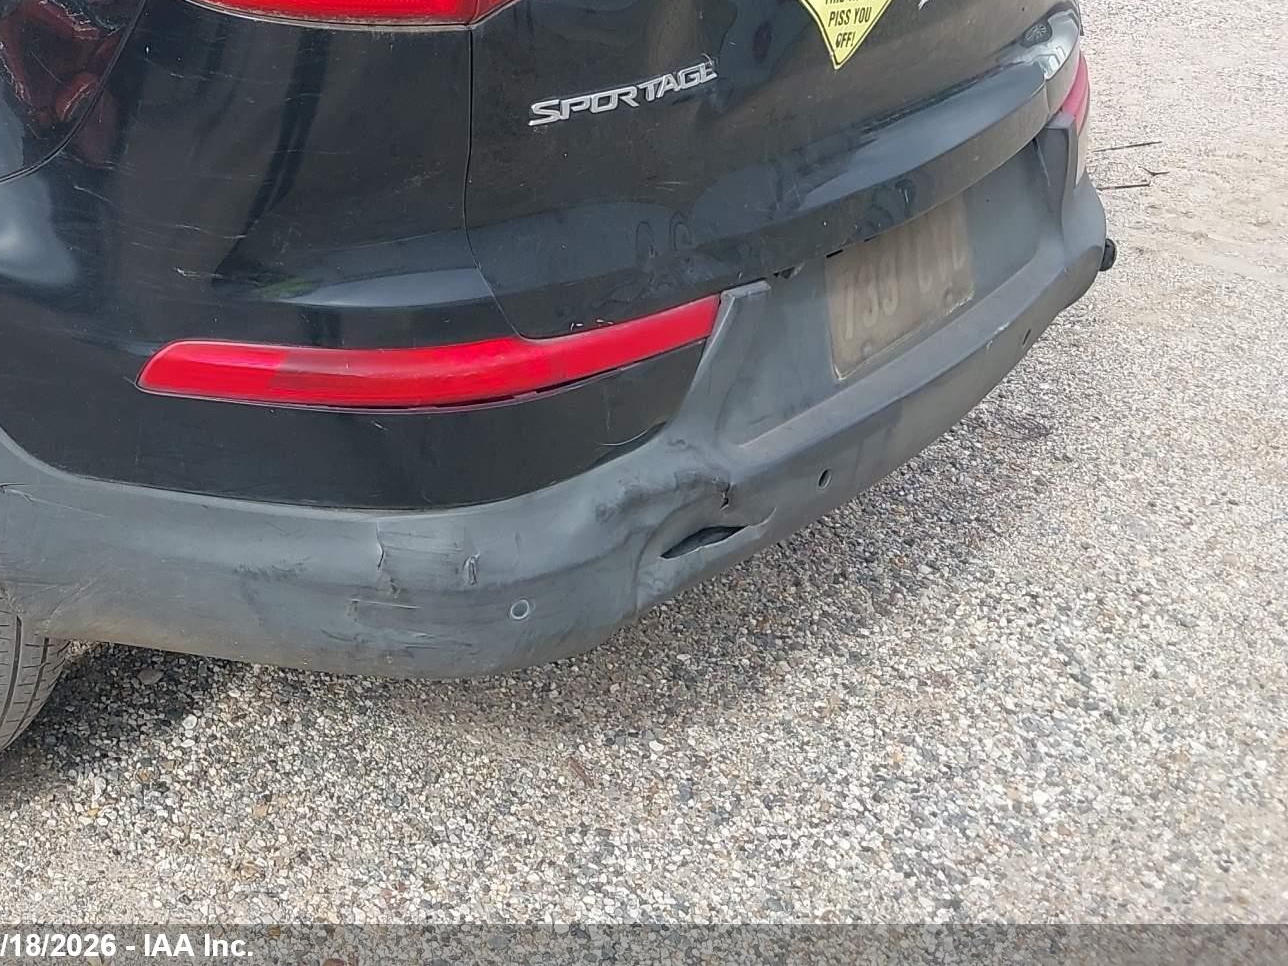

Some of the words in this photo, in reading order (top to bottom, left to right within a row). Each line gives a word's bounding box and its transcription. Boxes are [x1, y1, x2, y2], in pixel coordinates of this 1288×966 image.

[827, 10, 852, 28] PISS
[853, 6, 873, 25] YOU
[527, 60, 719, 126] SPORTAGE
